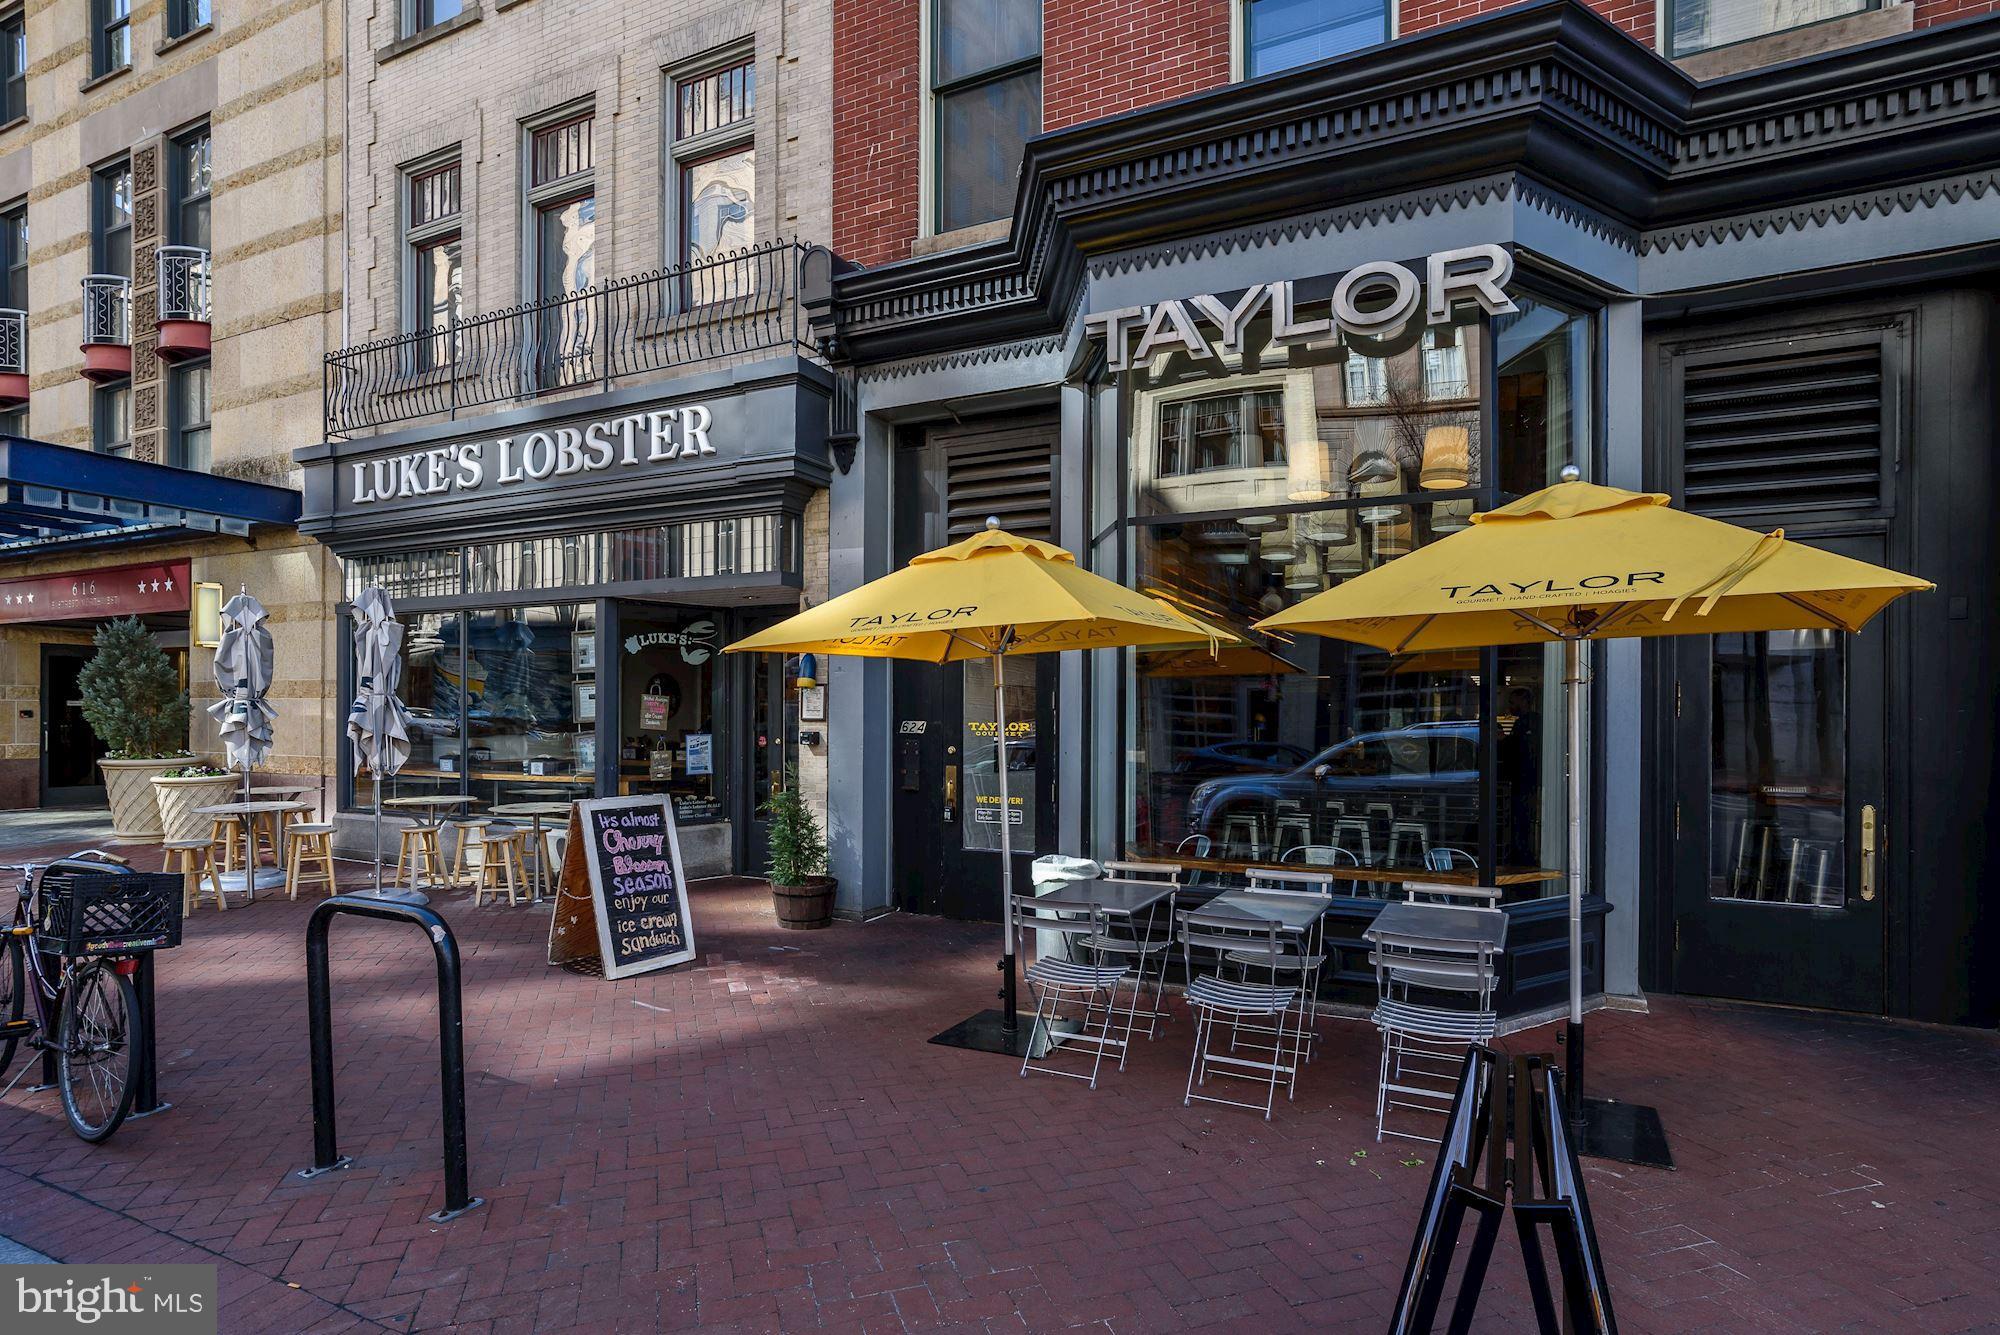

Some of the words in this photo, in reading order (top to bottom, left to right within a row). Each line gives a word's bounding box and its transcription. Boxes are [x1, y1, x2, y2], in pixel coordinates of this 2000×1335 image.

[1084, 243, 1519, 373] TAYLOR
[352, 442, 484, 504] LUKE'S
[496, 405, 718, 484] LOBSTER
[1441, 571, 1666, 599] TAYLOR
[1456, 596, 1500, 605] GOURMET
[1509, 592, 1582, 601] HAND-CRAFTED
[1593, 588, 1637, 596] HOAGIES
[850, 606, 978, 628] TAYLOR
[639, 632, 688, 646] LUKE'S
[902, 721, 925, 733] 624
[968, 722, 1031, 732] TAYOR
[976, 796, 988, 804] WE
[621, 811, 660, 827] almost
[603, 829, 664, 855] Cherry
[614, 895, 648, 912] enjoy
[652, 893, 669, 904] our
[617, 920, 636, 933] ice
[640, 912, 677, 929] cream
[621, 929, 680, 955] sandwich
